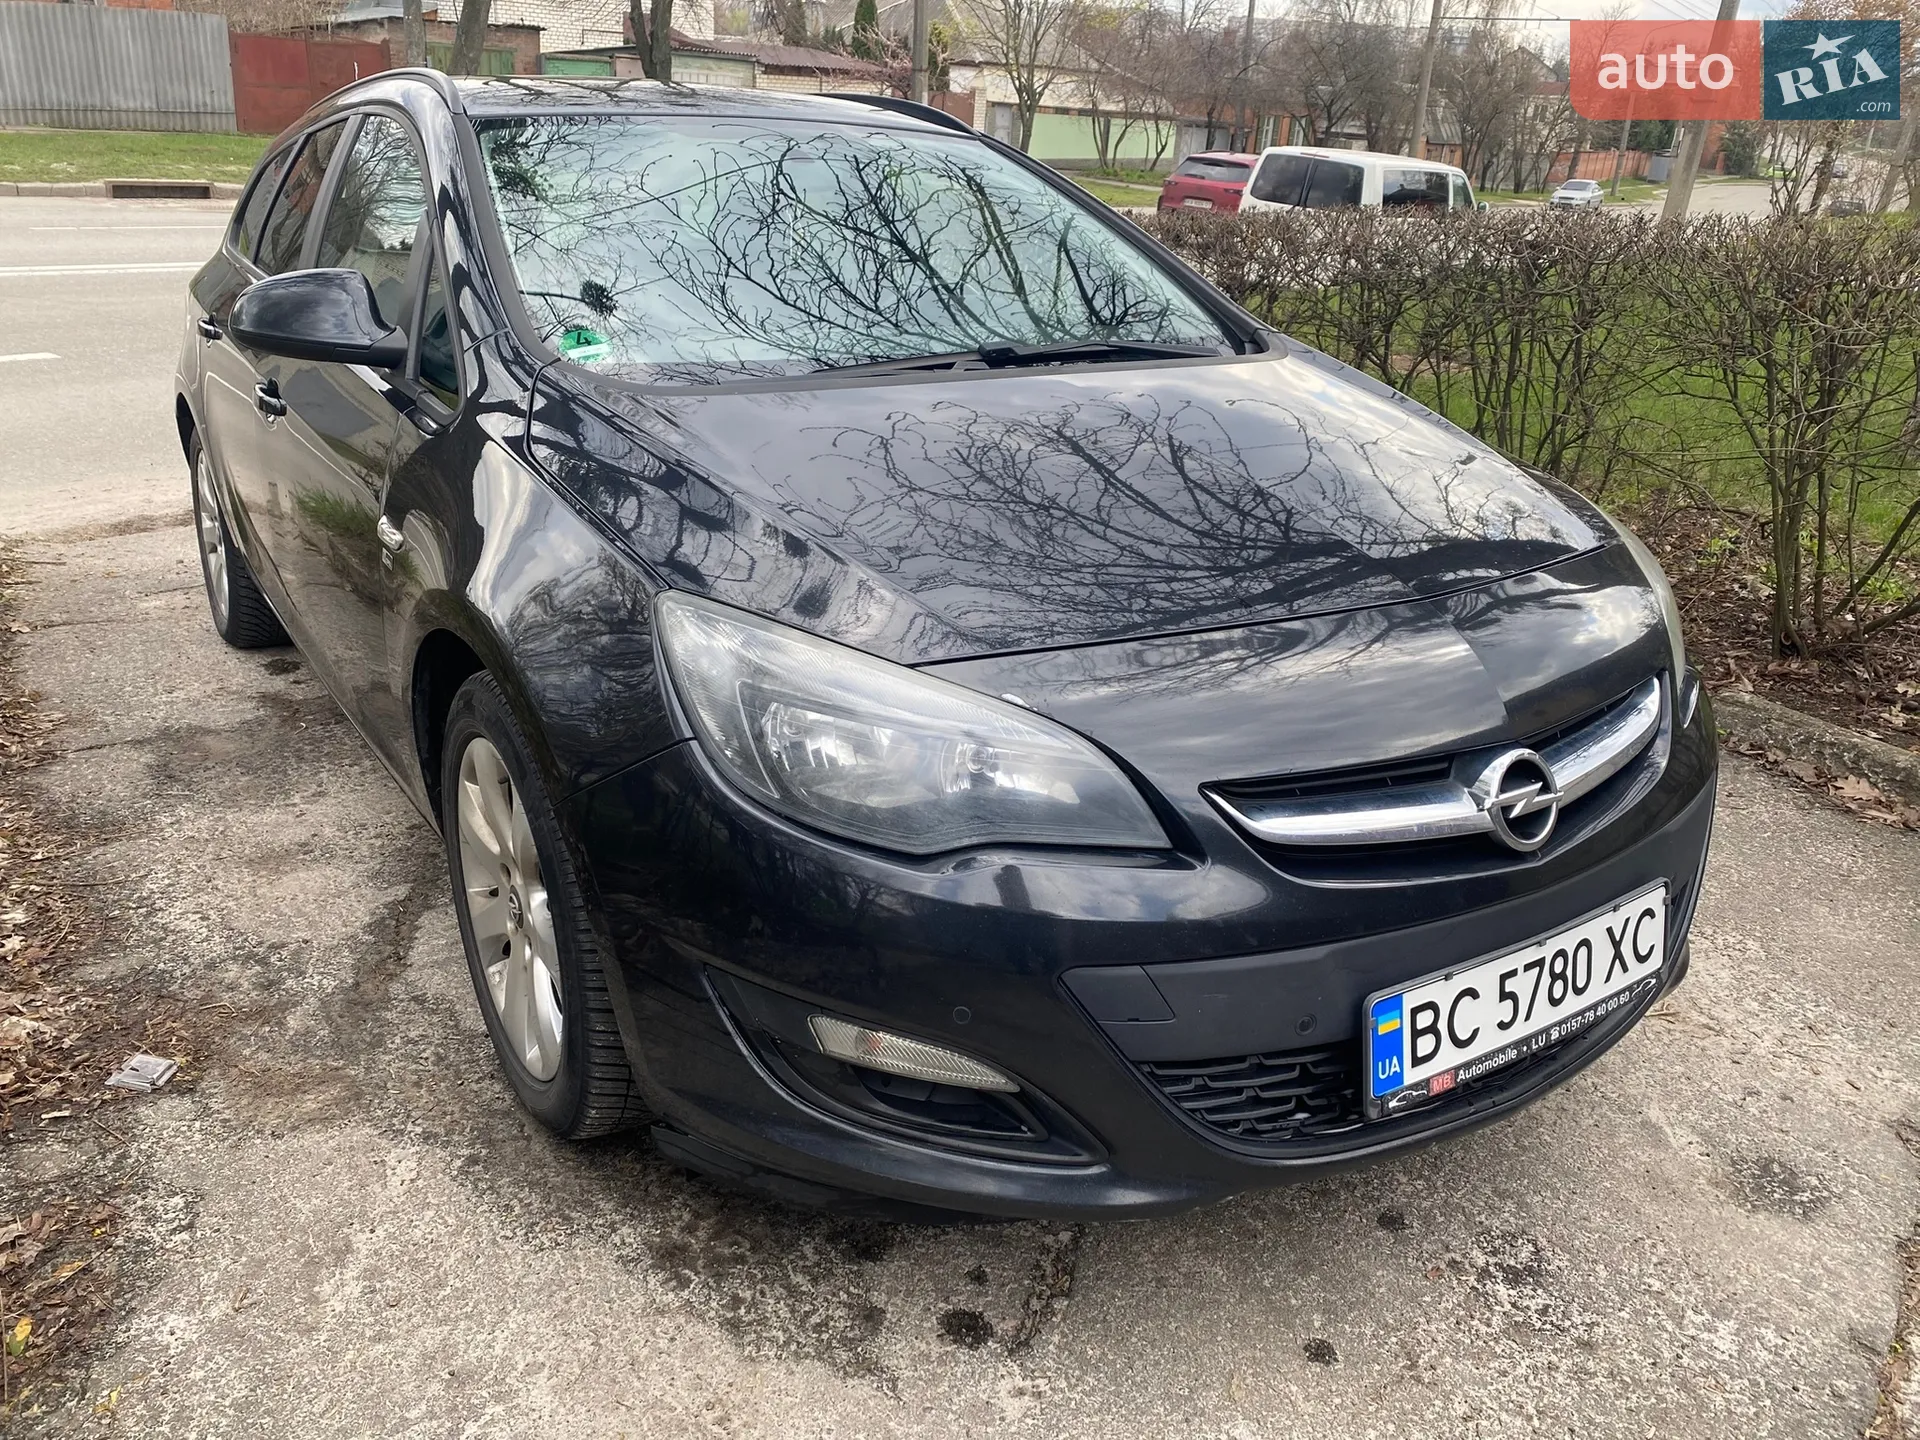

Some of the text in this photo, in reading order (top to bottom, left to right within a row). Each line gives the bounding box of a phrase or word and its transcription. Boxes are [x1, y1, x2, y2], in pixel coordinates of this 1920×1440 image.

[576, 331, 592, 346] 4
[1410, 907, 1657, 1069] BC 5780 XC
[1378, 1055, 1401, 1079] UA
[1433, 1075, 1452, 1092] MB
[1456, 1047, 1518, 1082] Automobile
[1531, 1033, 1547, 1050] LU
[1561, 1009, 1595, 1036] 0157-78
[1596, 1003, 1607, 1017] 40
[1607, 997, 1618, 1012] 00
